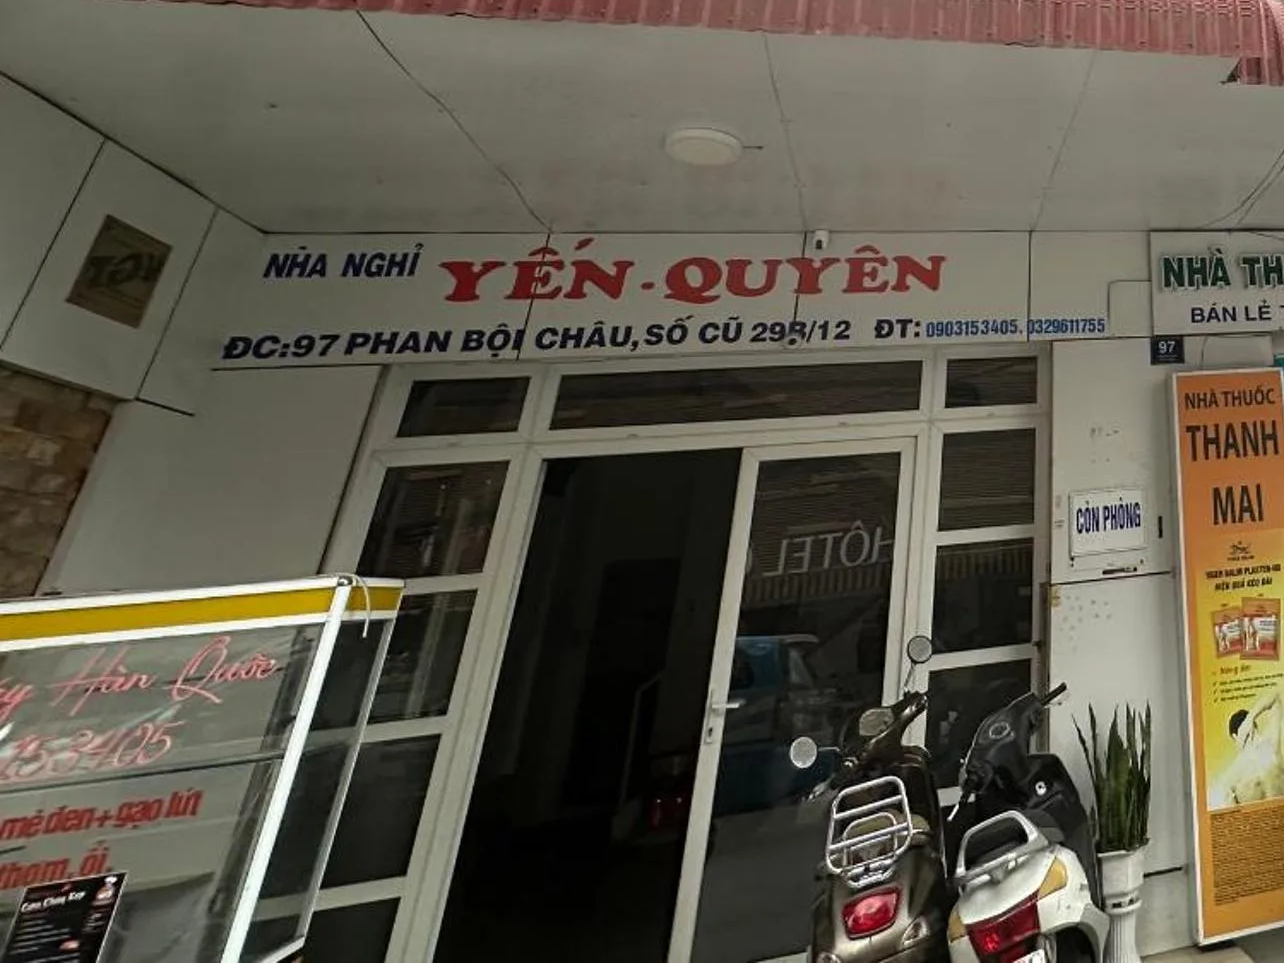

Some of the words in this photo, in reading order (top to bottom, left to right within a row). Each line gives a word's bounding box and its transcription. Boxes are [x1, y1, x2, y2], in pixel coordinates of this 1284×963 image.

[341, 243, 425, 278] NGHỈ
[1161, 250, 1232, 290] NHÀ
[1190, 300, 1239, 324] BÁN
[1244, 299, 1272, 322] LẺ
[344, 330, 450, 357] PHAN
[461, 324, 525, 359] BỘI
[1158, 340, 1176, 354] 97
[1184, 390, 1219, 410] NHÀ
[1221, 384, 1276, 407] THUỐC
[1186, 420, 1280, 462] THANH
[1075, 500, 1101, 535] CÒN
[1102, 498, 1142, 531] PHÒNG
[1212, 484, 1265, 526] MAI
